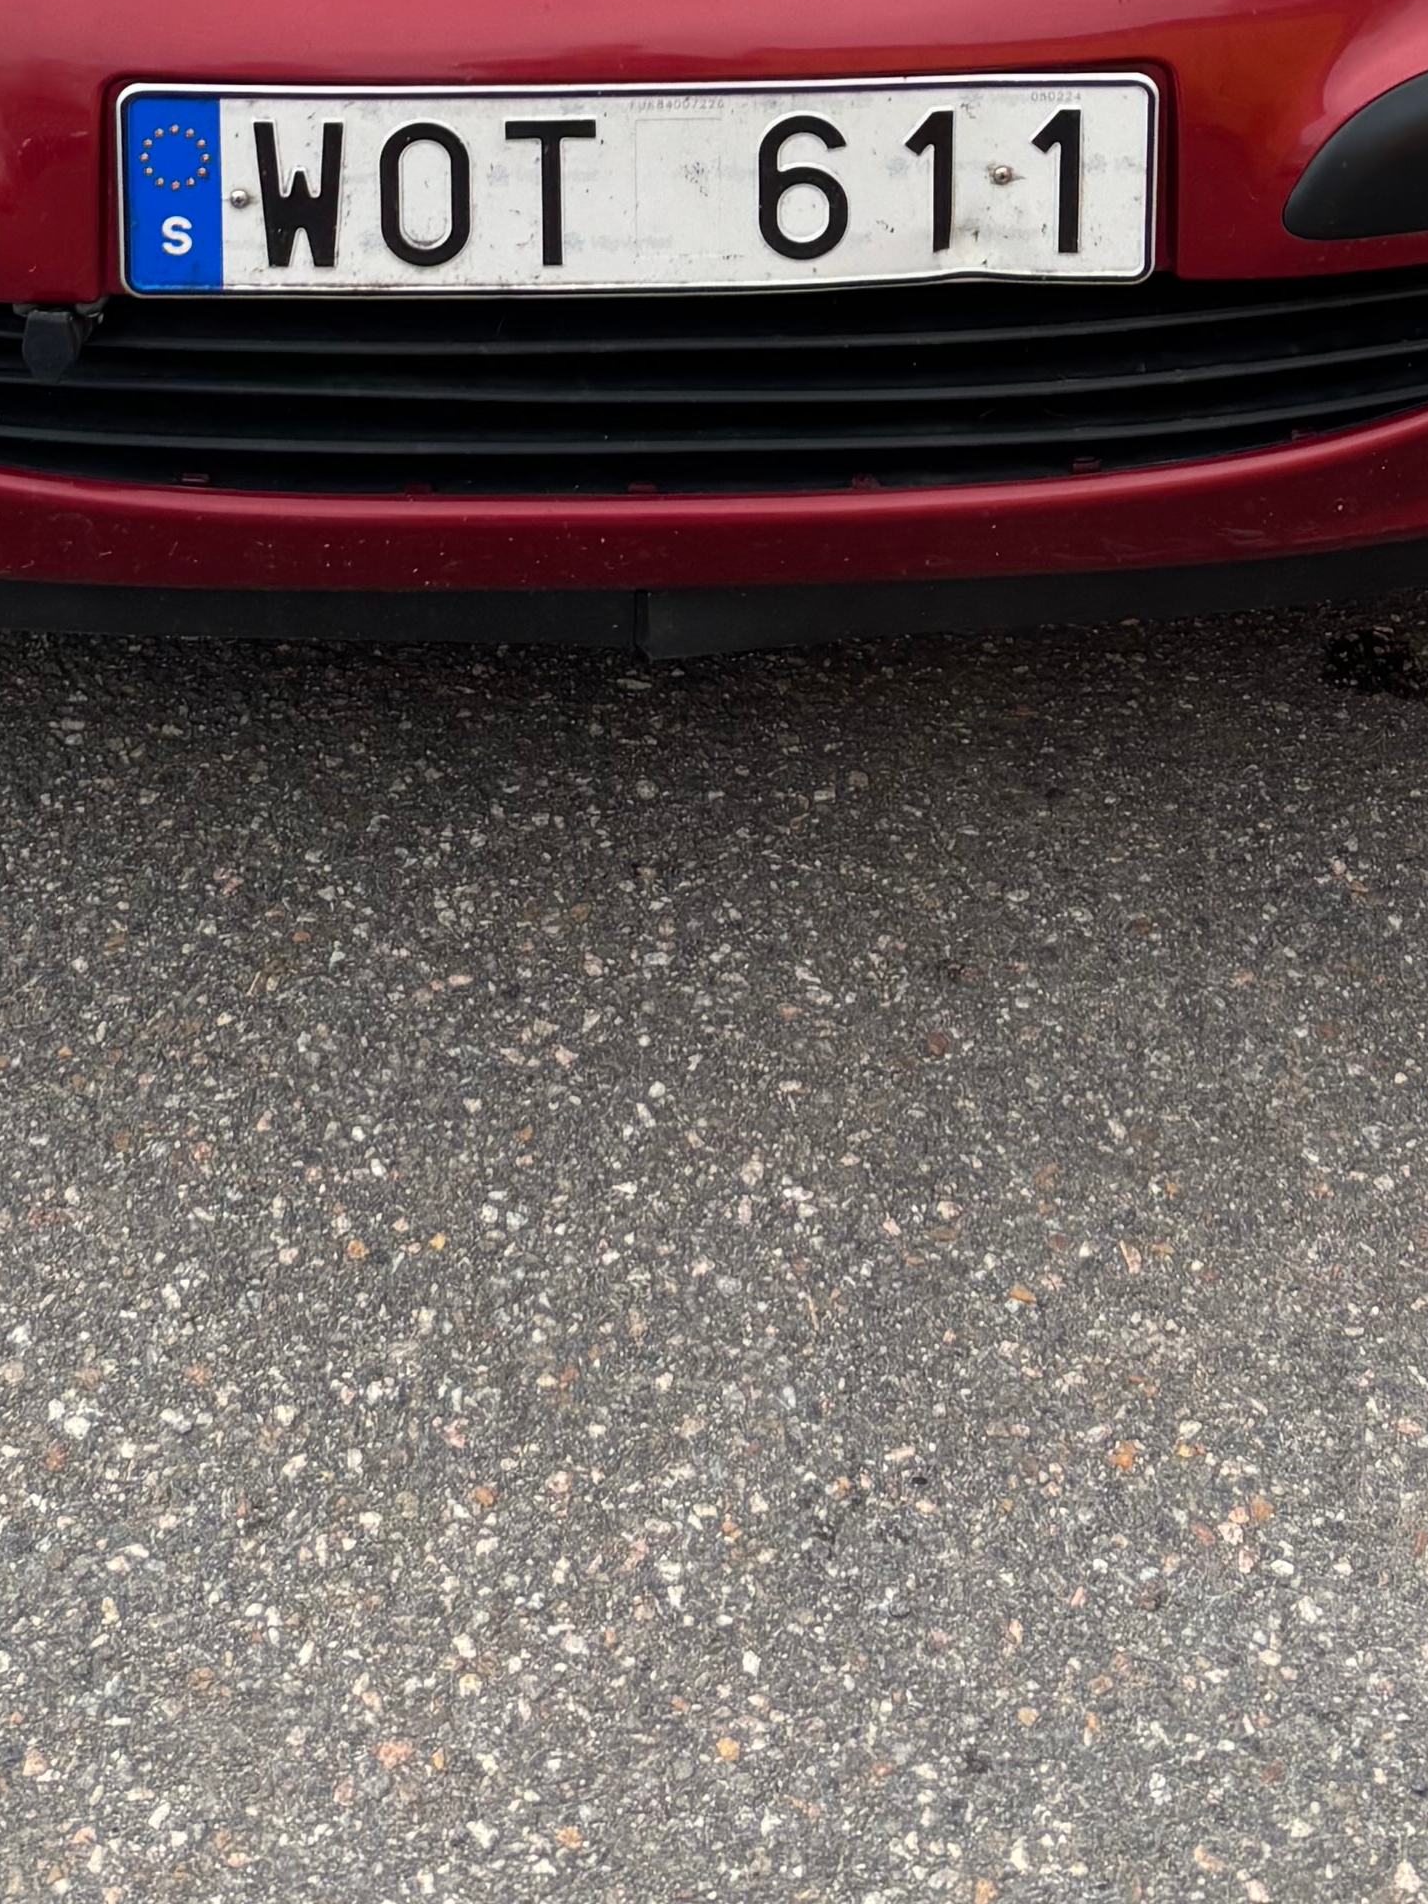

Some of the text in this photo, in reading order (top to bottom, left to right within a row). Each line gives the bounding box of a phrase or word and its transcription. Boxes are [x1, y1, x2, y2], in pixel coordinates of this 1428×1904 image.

[161, 215, 193, 256] S
[253, 109, 1082, 267] WOT 611
